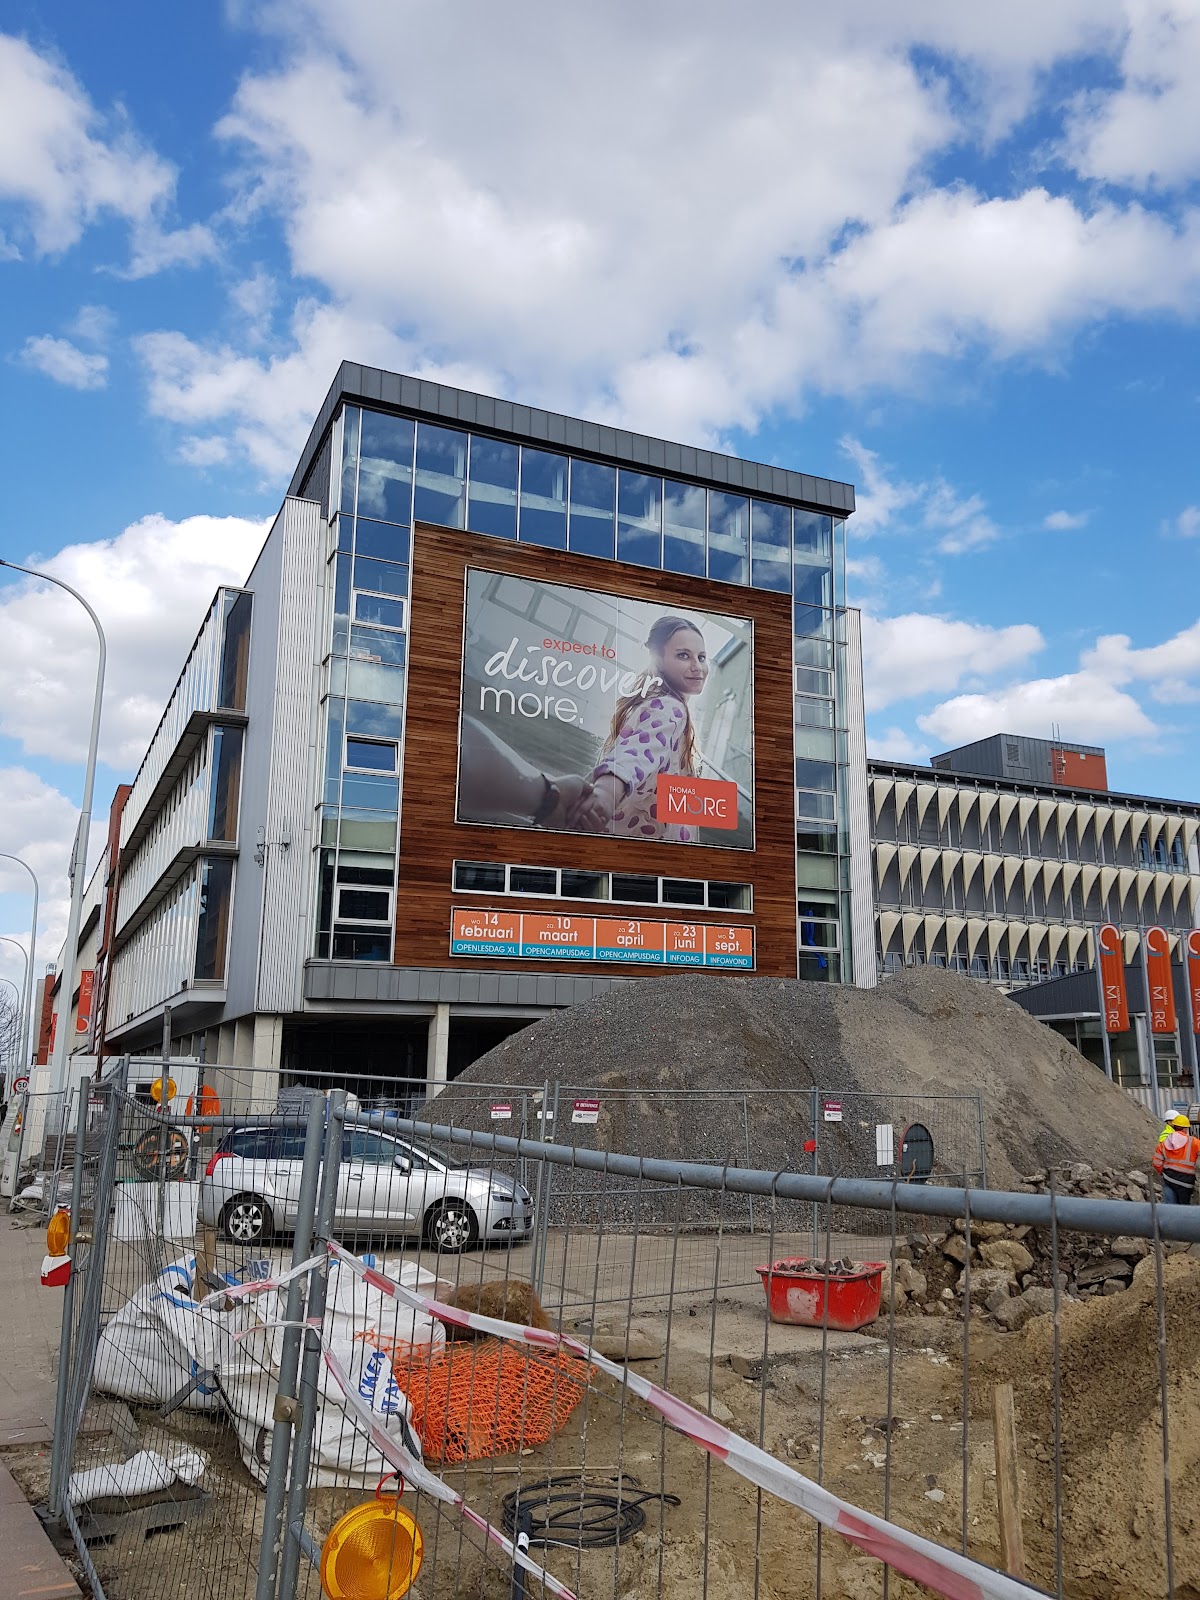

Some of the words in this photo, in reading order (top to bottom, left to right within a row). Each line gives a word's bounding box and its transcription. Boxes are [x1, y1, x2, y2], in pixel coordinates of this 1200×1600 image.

[543, 637, 597, 657] expect
[601, 644, 616, 659] to
[484, 636, 663, 699] discover
[480, 686, 584, 724] more.
[669, 785, 696, 795] THOMAS
[668, 793, 727, 818] MORE
[484, 913, 499, 926] 14
[557, 917, 571, 930] 10
[460, 925, 514, 939] februari
[628, 922, 641, 934] 21
[682, 926, 697, 937] 23
[728, 928, 735, 940] 5
[539, 930, 578, 942] maart
[616, 934, 644, 946] april
[456, 943, 505, 953] OPENLESDAG
[507, 946, 516, 954] XL
[674, 937, 696, 950] juni
[715, 941, 743, 953] sept.
[525, 947, 590, 957] OPENCAMPUSDAG
[599, 950, 661, 961] OPENCAMPUSDAG
[669, 954, 700, 963] INFODAG
[710, 957, 748, 966] INFOAVOND
[17, 1081, 28, 1089] 50
